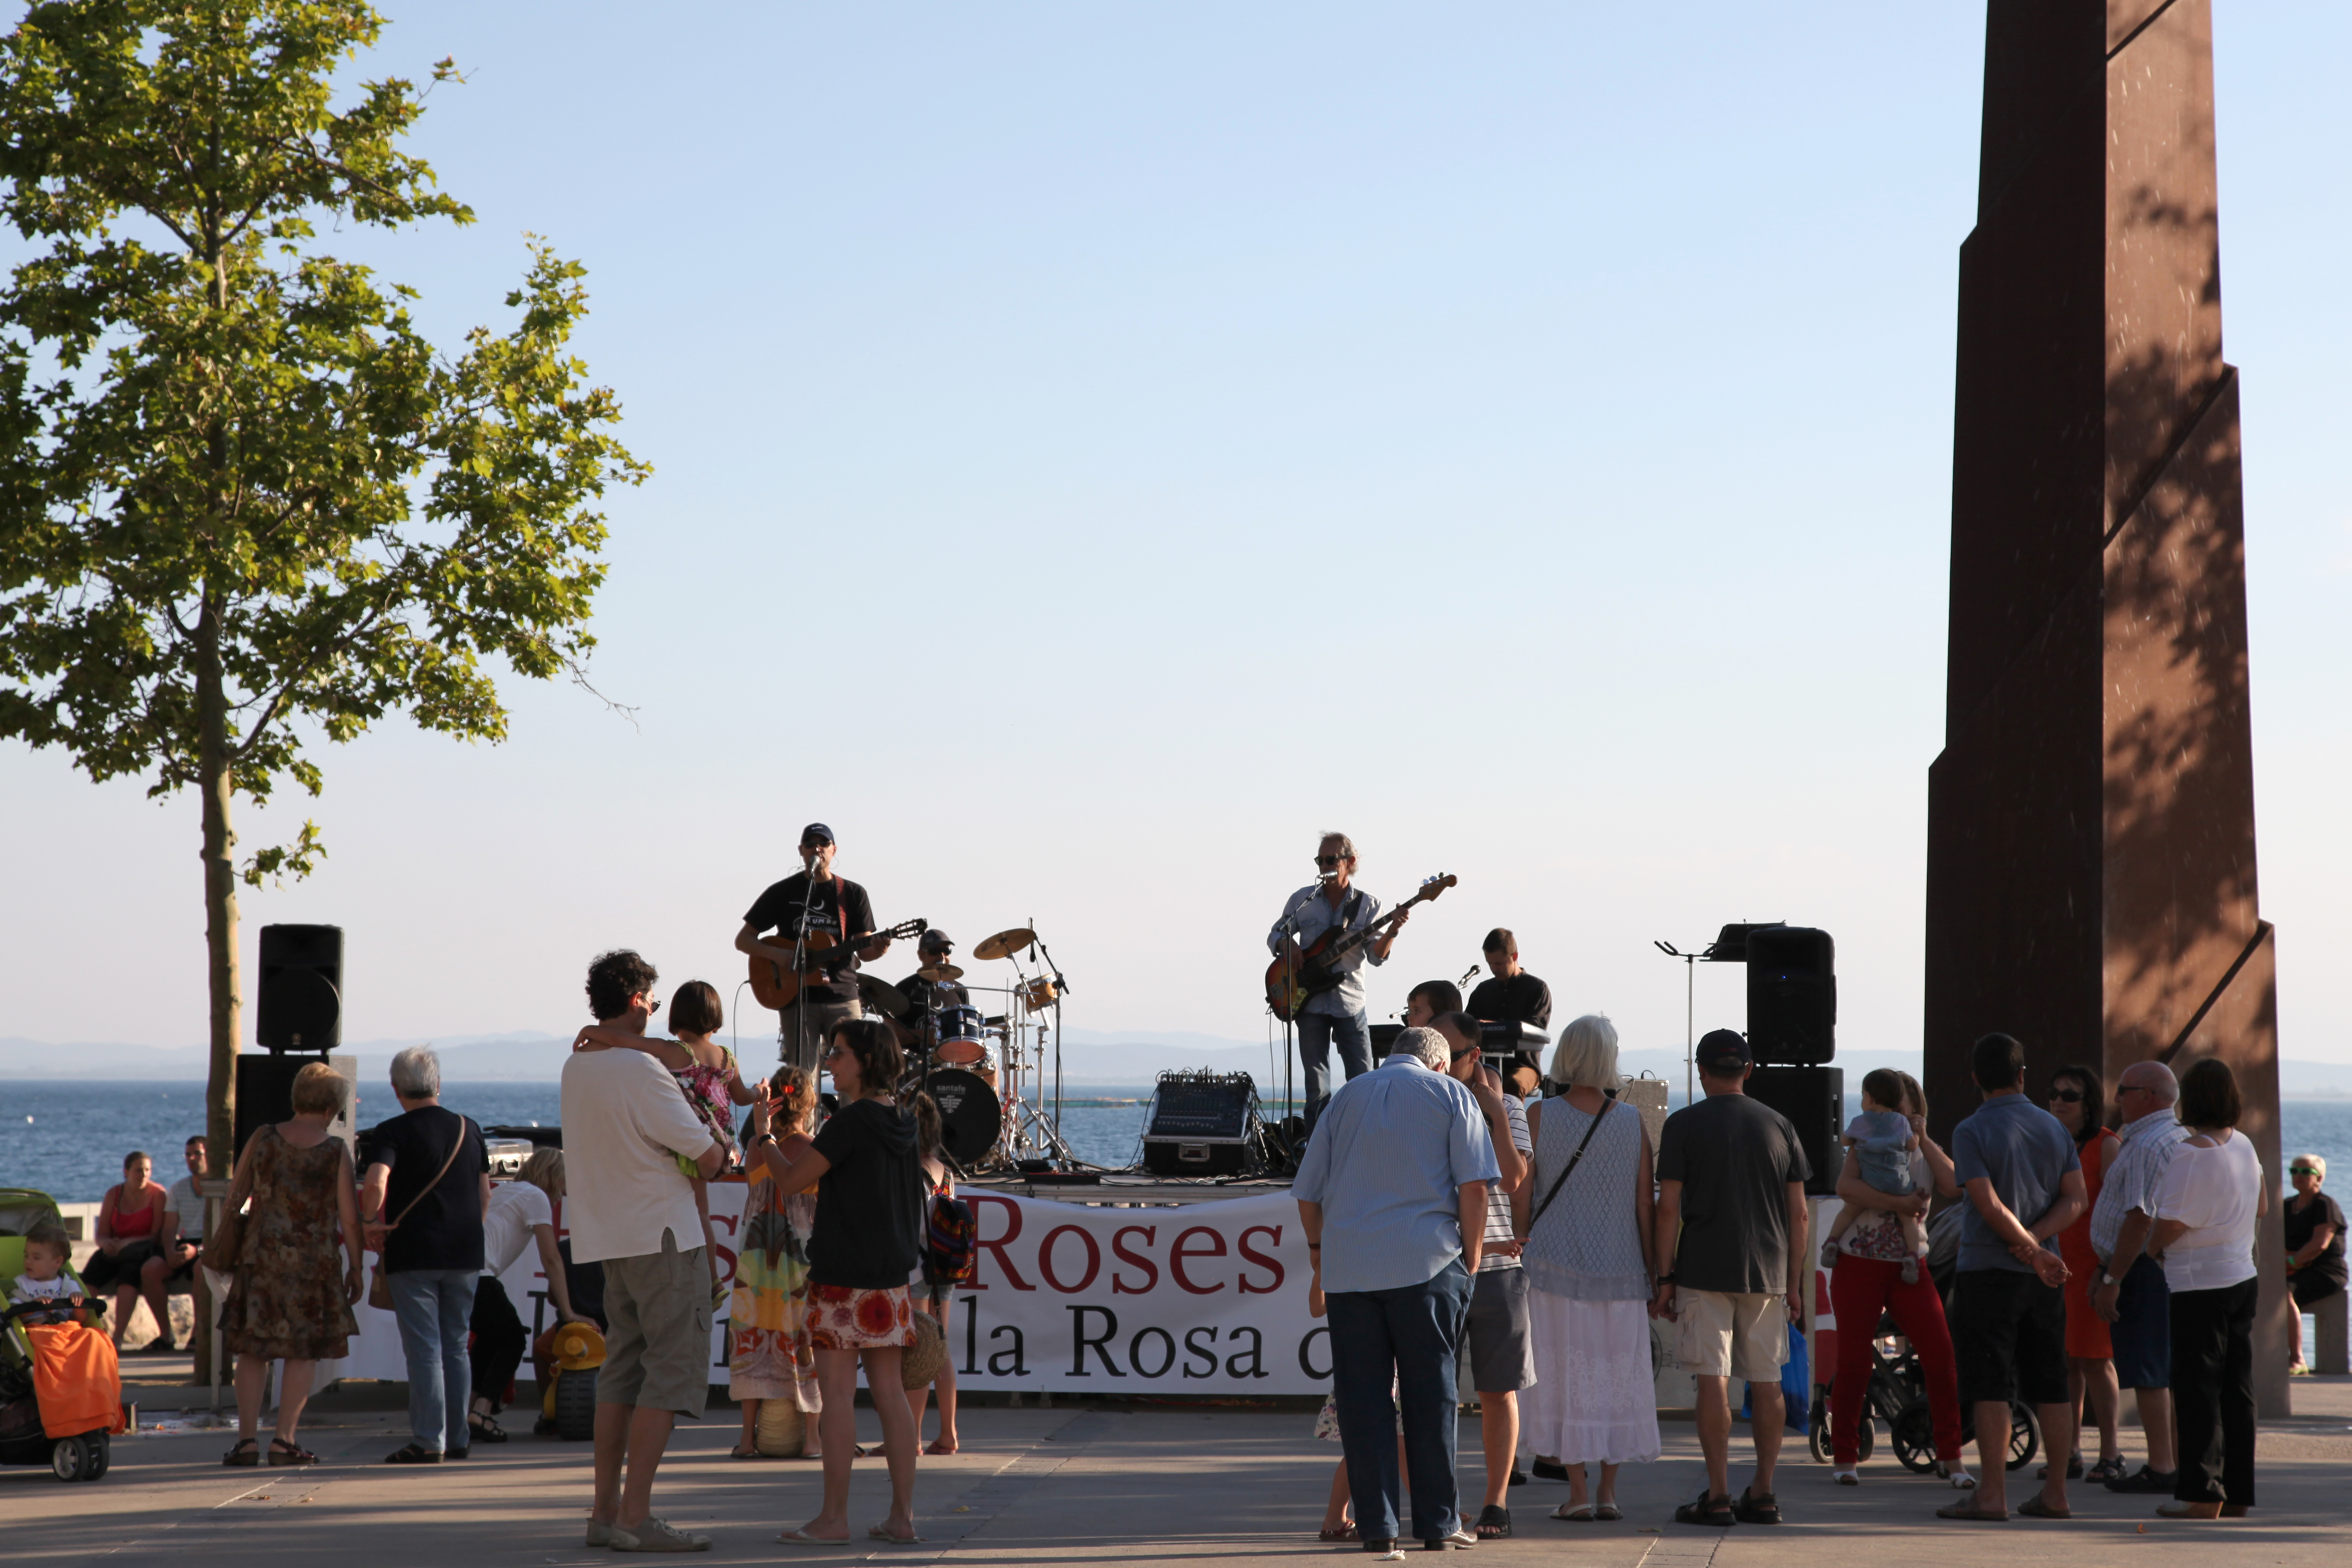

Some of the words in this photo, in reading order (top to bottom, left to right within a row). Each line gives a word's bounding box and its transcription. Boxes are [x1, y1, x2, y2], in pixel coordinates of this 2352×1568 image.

[805, 917, 837, 925] RUMBA
[955, 1195, 1285, 1295] Roses
[958, 1295, 1031, 1377] la
[1065, 1305, 1269, 1379] Rosa
